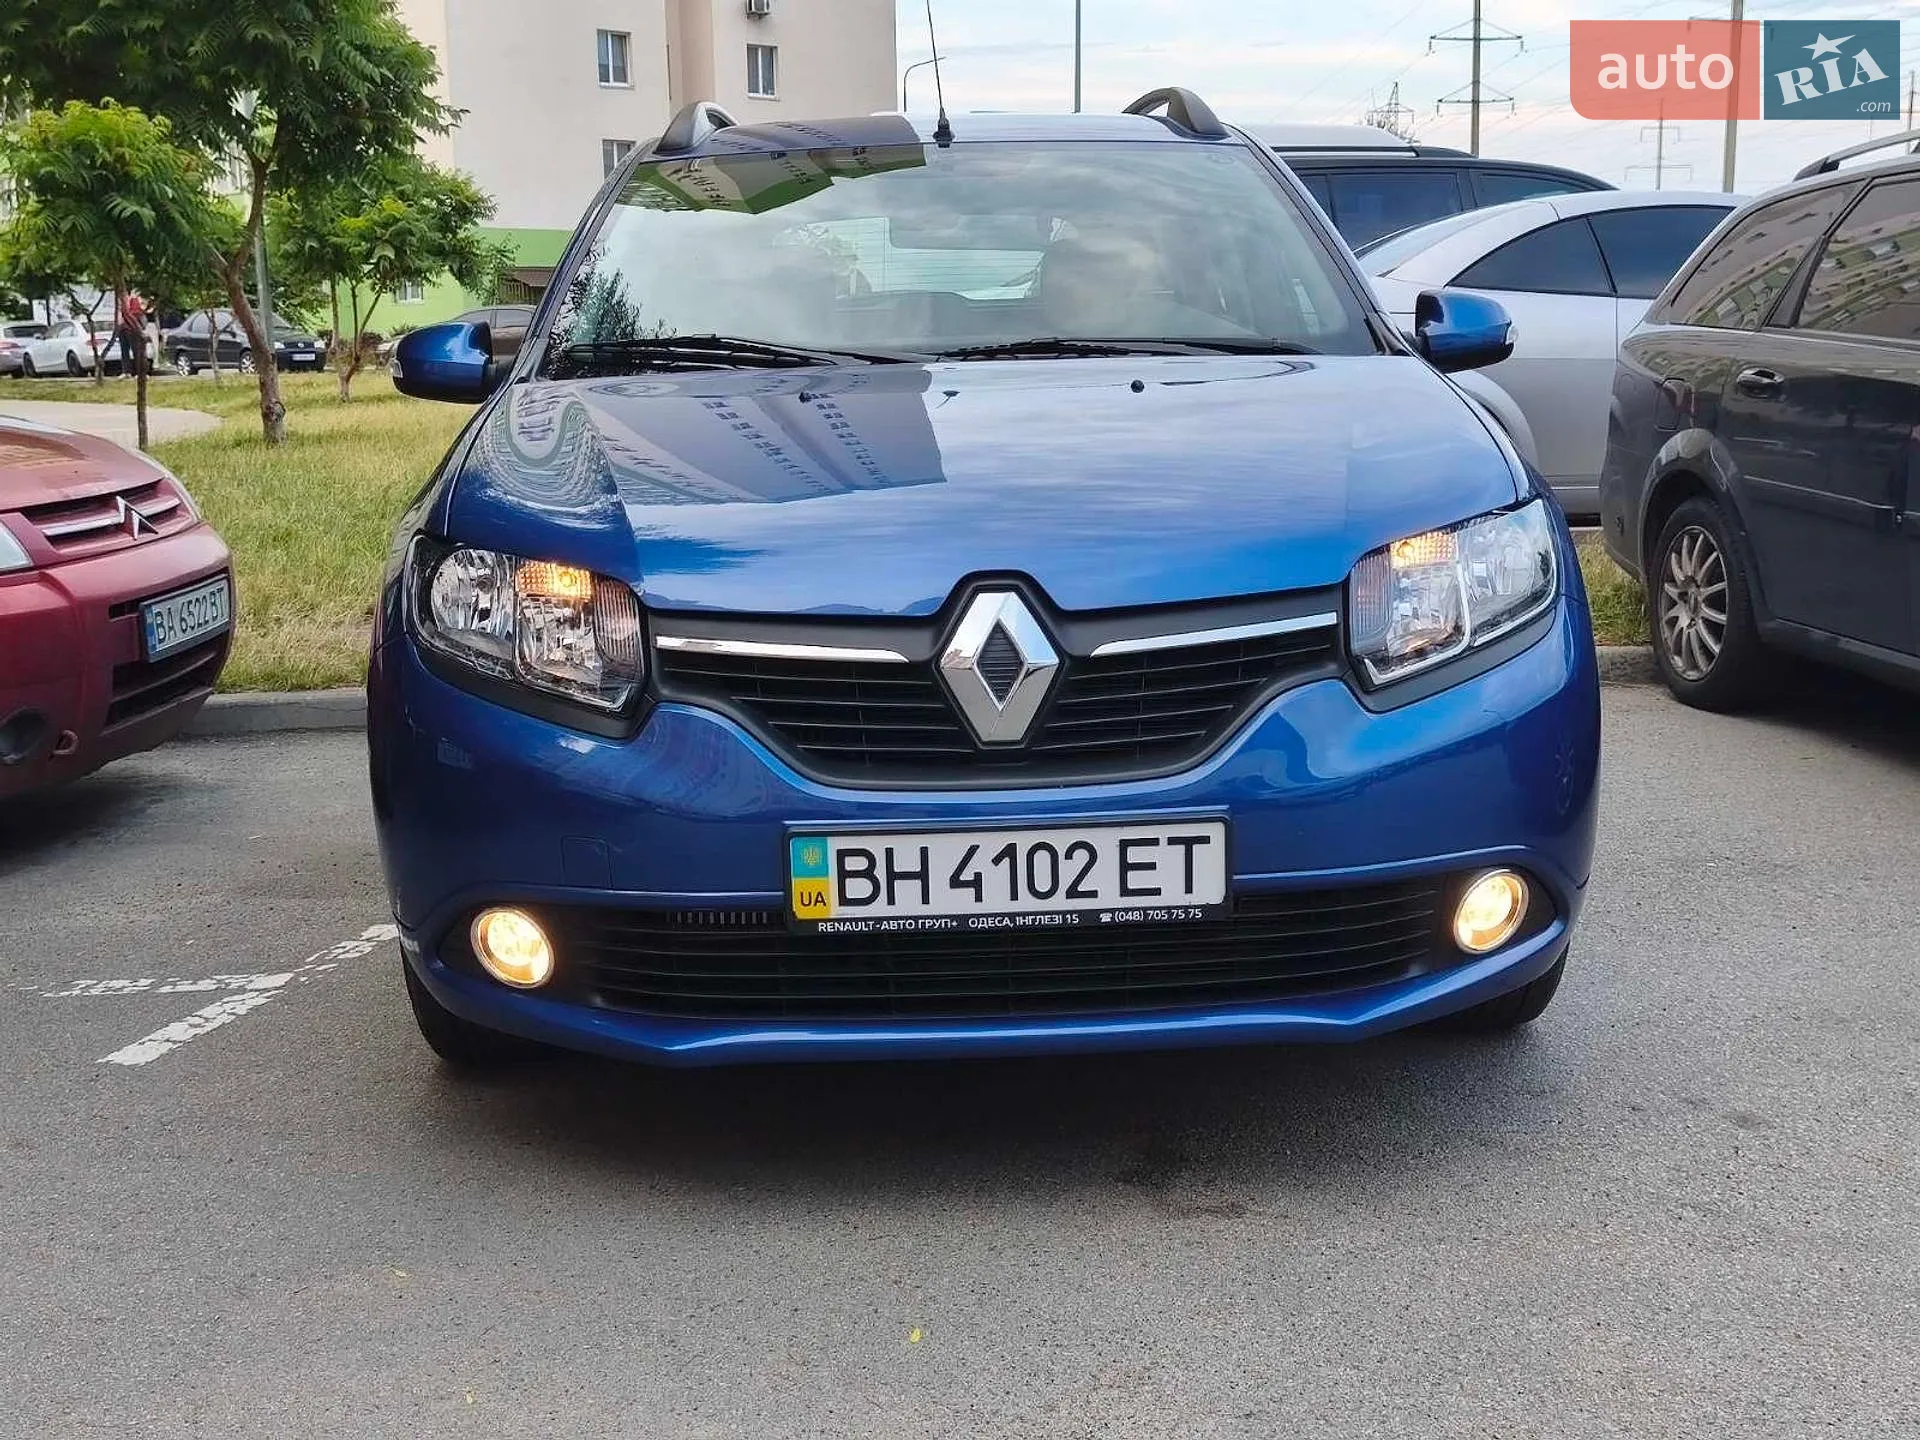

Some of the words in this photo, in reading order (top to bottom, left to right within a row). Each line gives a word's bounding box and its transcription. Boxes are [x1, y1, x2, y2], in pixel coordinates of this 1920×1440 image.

[154, 607, 177, 643] BA
[179, 594, 210, 635] 6522
[210, 587, 224, 621] BT
[836, 845, 930, 907] BH
[949, 840, 1099, 903] 4102
[1118, 835, 1211, 898] ET
[800, 891, 827, 907] UA
[968, 917, 1014, 928] ОДЕСА,
[1065, 914, 1079, 924] 15
[1114, 911, 1144, 922] (048)
[1147, 910, 1168, 920] 705
[1171, 909, 1186, 919] 75
[1188, 908, 1203, 918] 75
